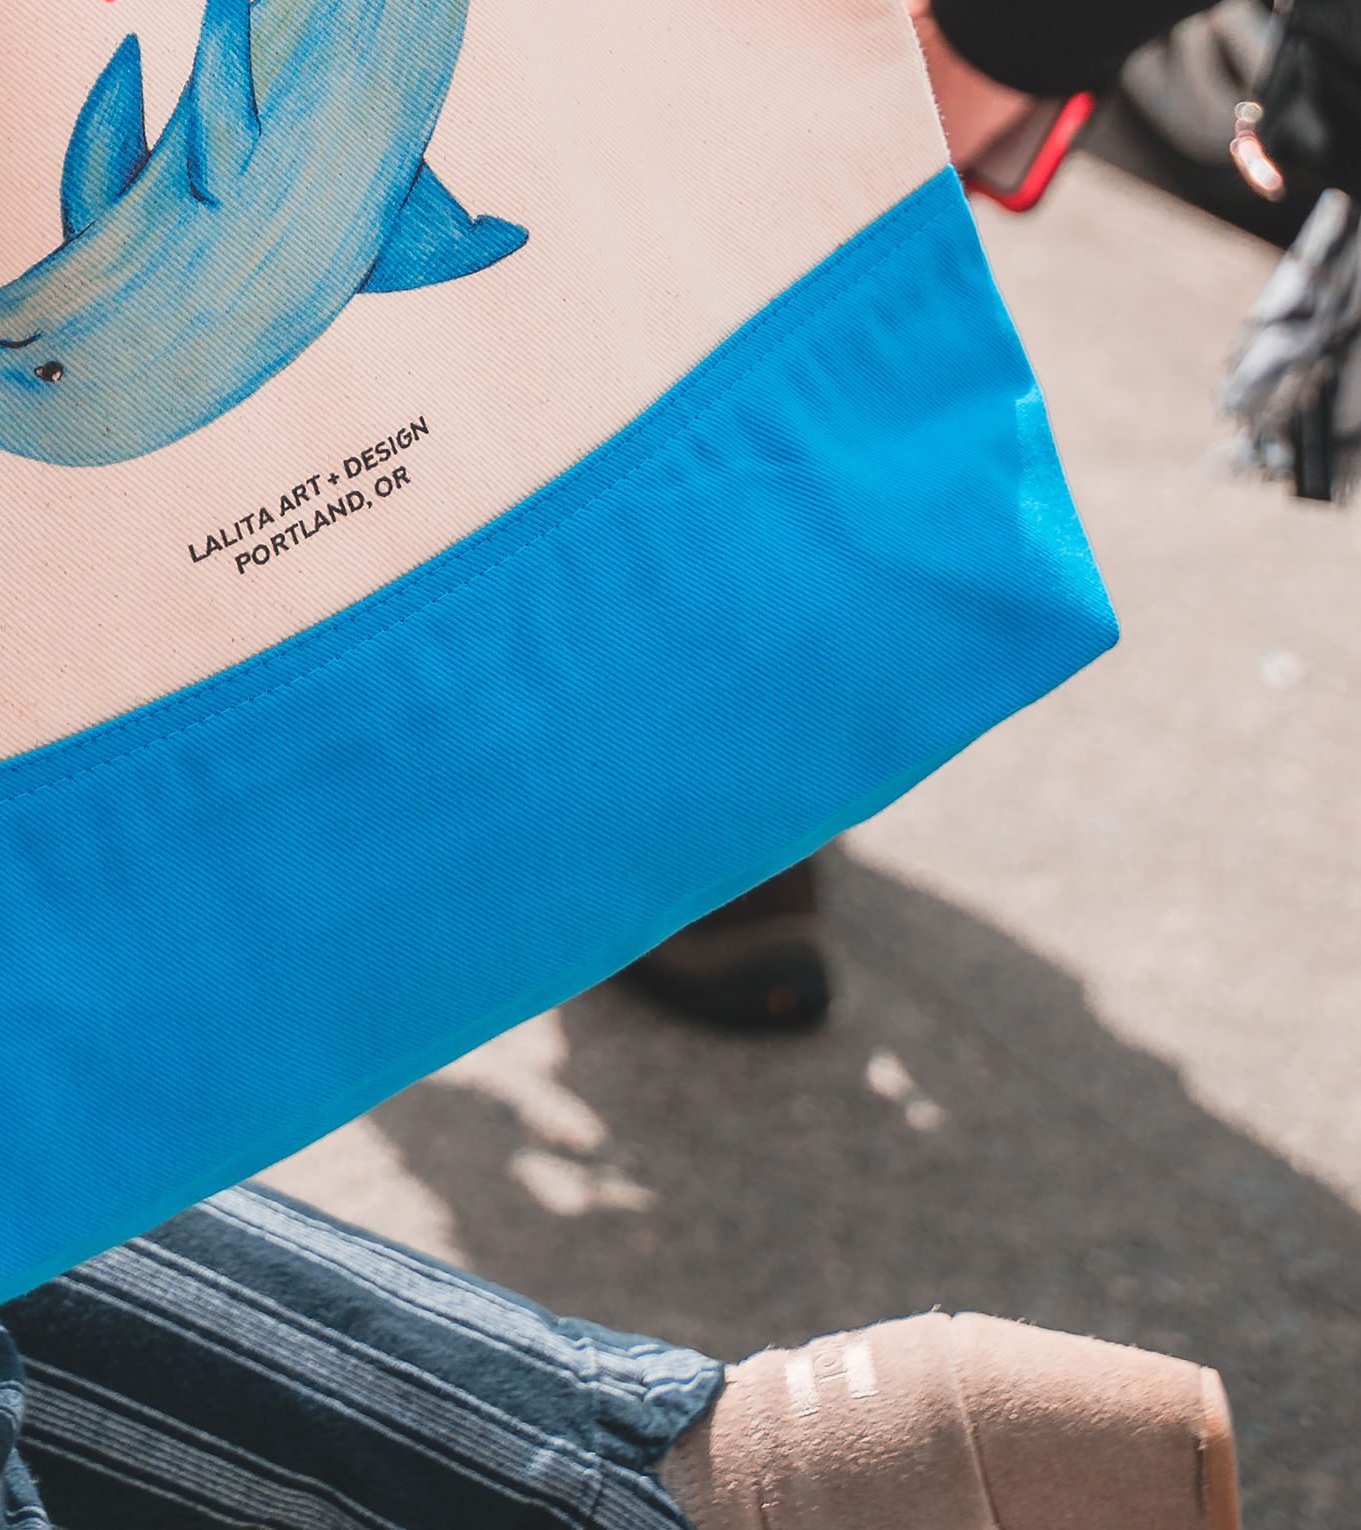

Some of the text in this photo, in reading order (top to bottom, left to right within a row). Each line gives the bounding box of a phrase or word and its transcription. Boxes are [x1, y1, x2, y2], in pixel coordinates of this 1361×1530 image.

[188, 416, 430, 563] LALITA ART + DESIGN
[234, 466, 411, 575] PORTLAND, OR
